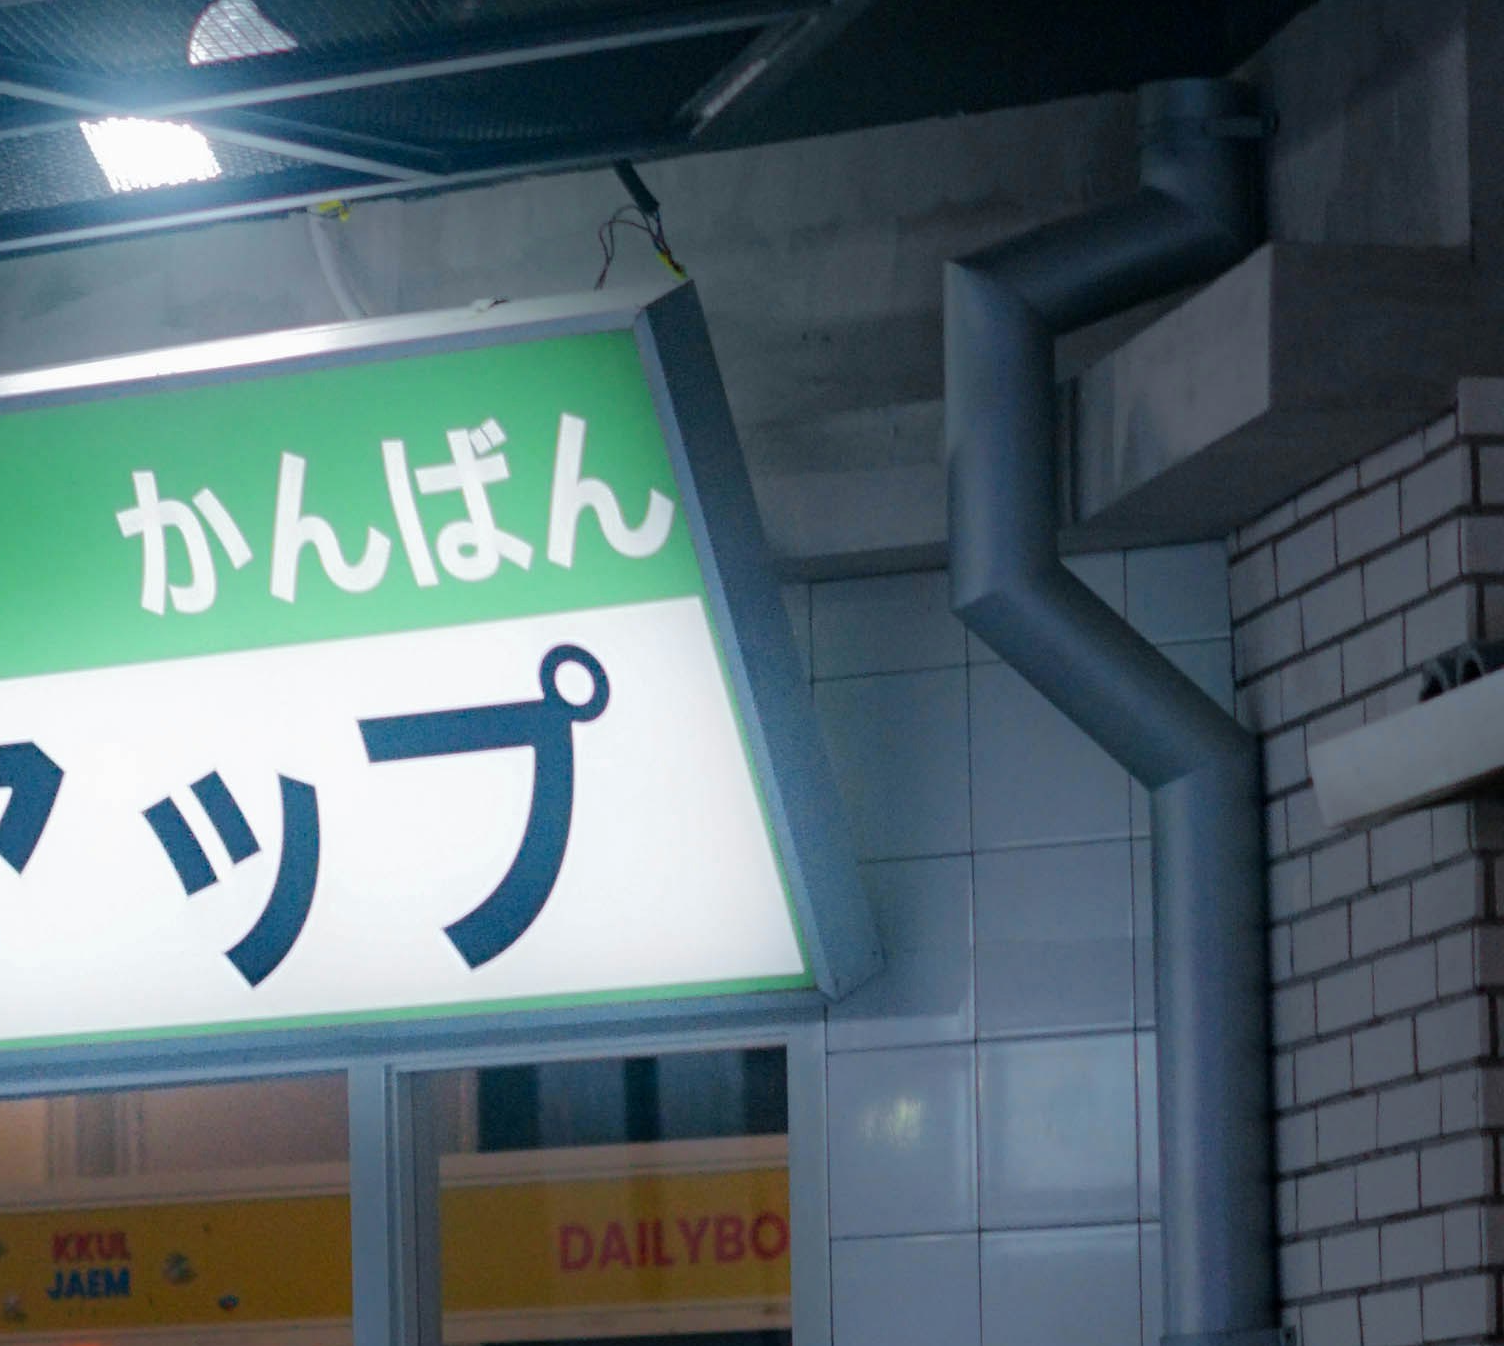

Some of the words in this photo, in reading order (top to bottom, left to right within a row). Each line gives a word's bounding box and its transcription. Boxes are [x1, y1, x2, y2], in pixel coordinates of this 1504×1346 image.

[115, 411, 675, 617] かんばん
[52, 1230, 131, 1261] KKUL
[559, 1211, 789, 1272] DAILYBO
[47, 1266, 131, 1300] JAEM
